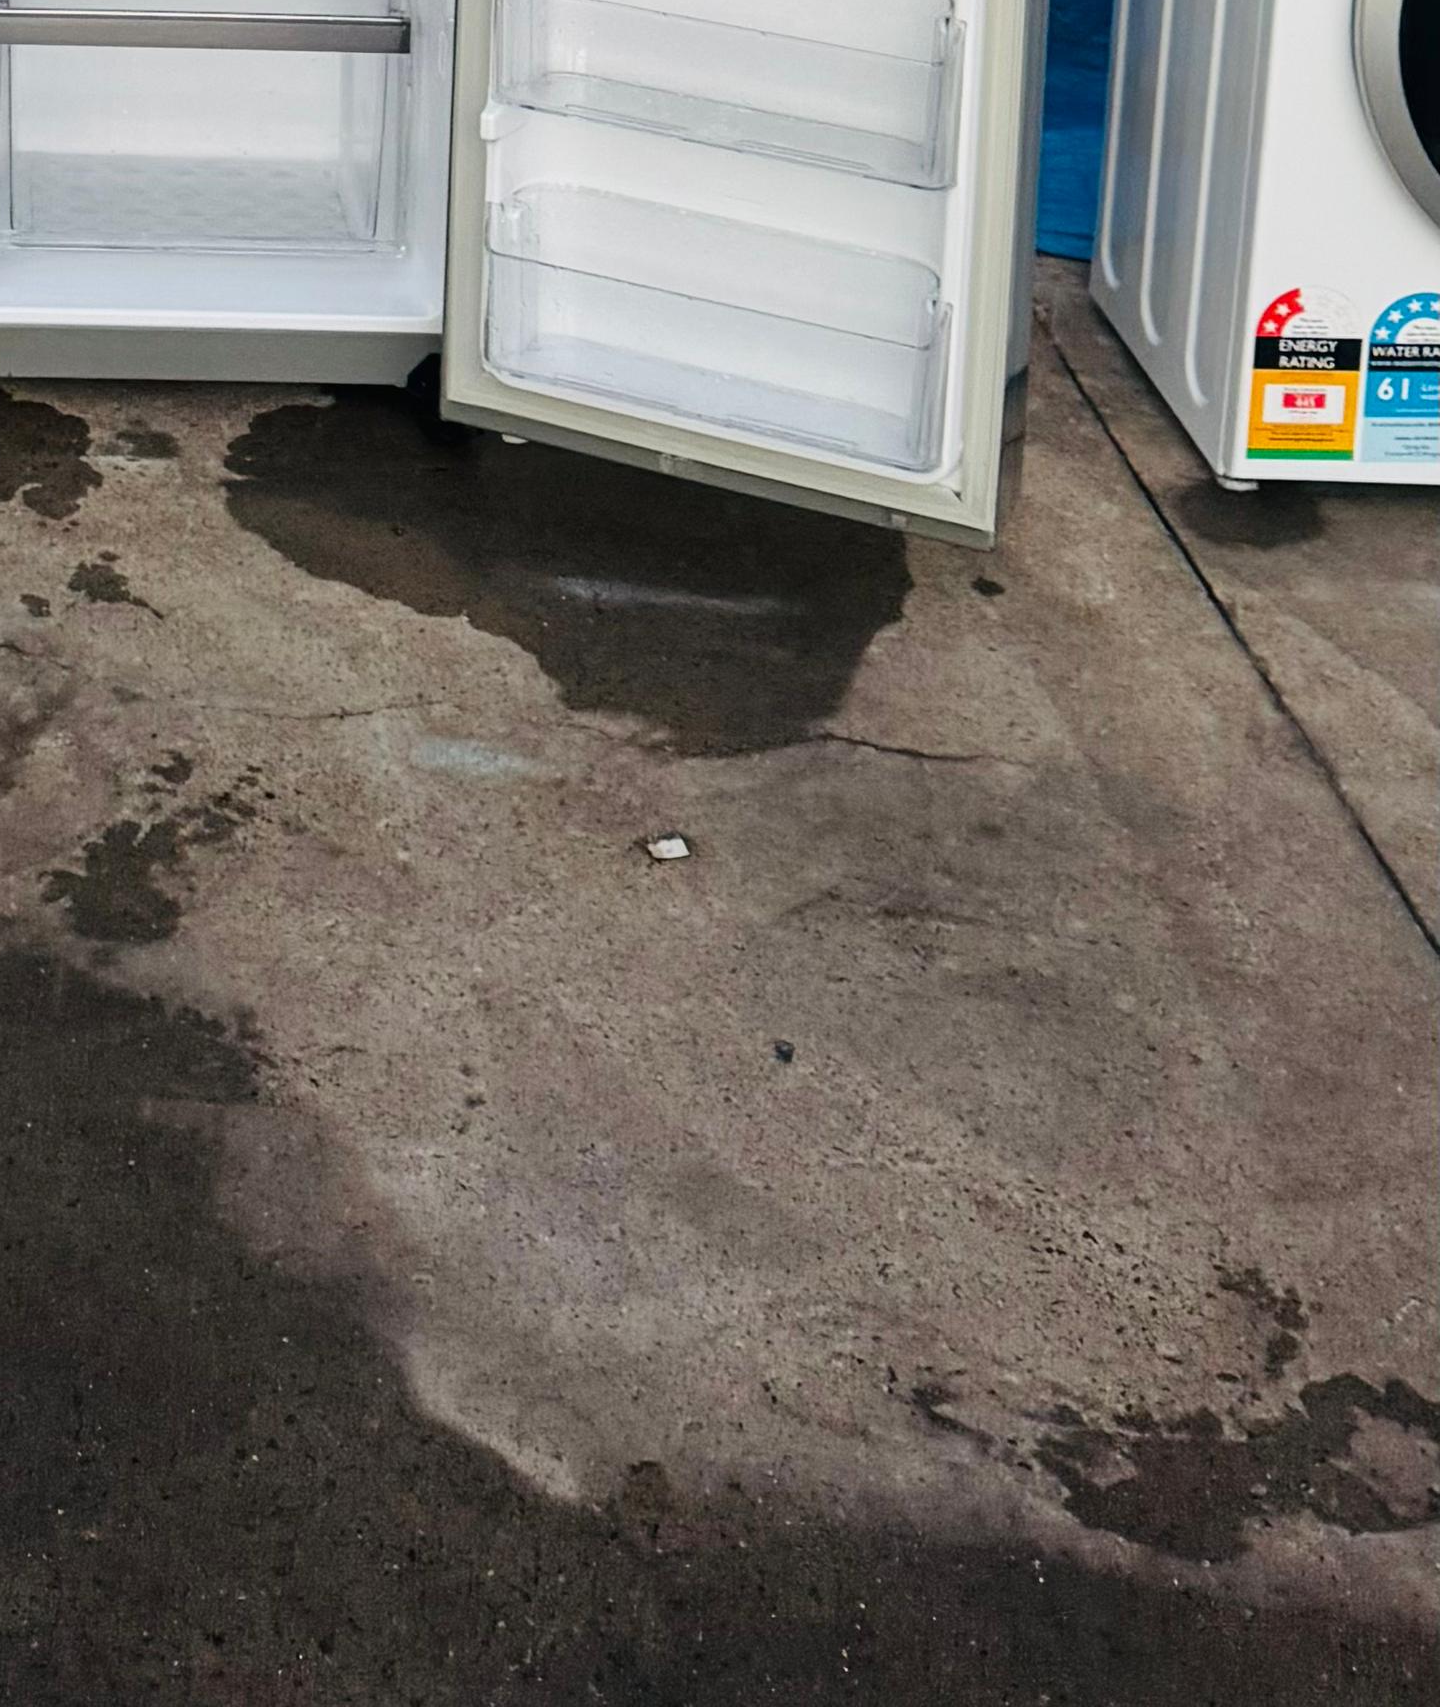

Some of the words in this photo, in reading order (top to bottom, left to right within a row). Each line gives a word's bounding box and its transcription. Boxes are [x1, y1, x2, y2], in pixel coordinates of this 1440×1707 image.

[1278, 340, 1338, 353] ENERGY
[1372, 345, 1420, 357] WATER
[1278, 356, 1335, 369] RATING
